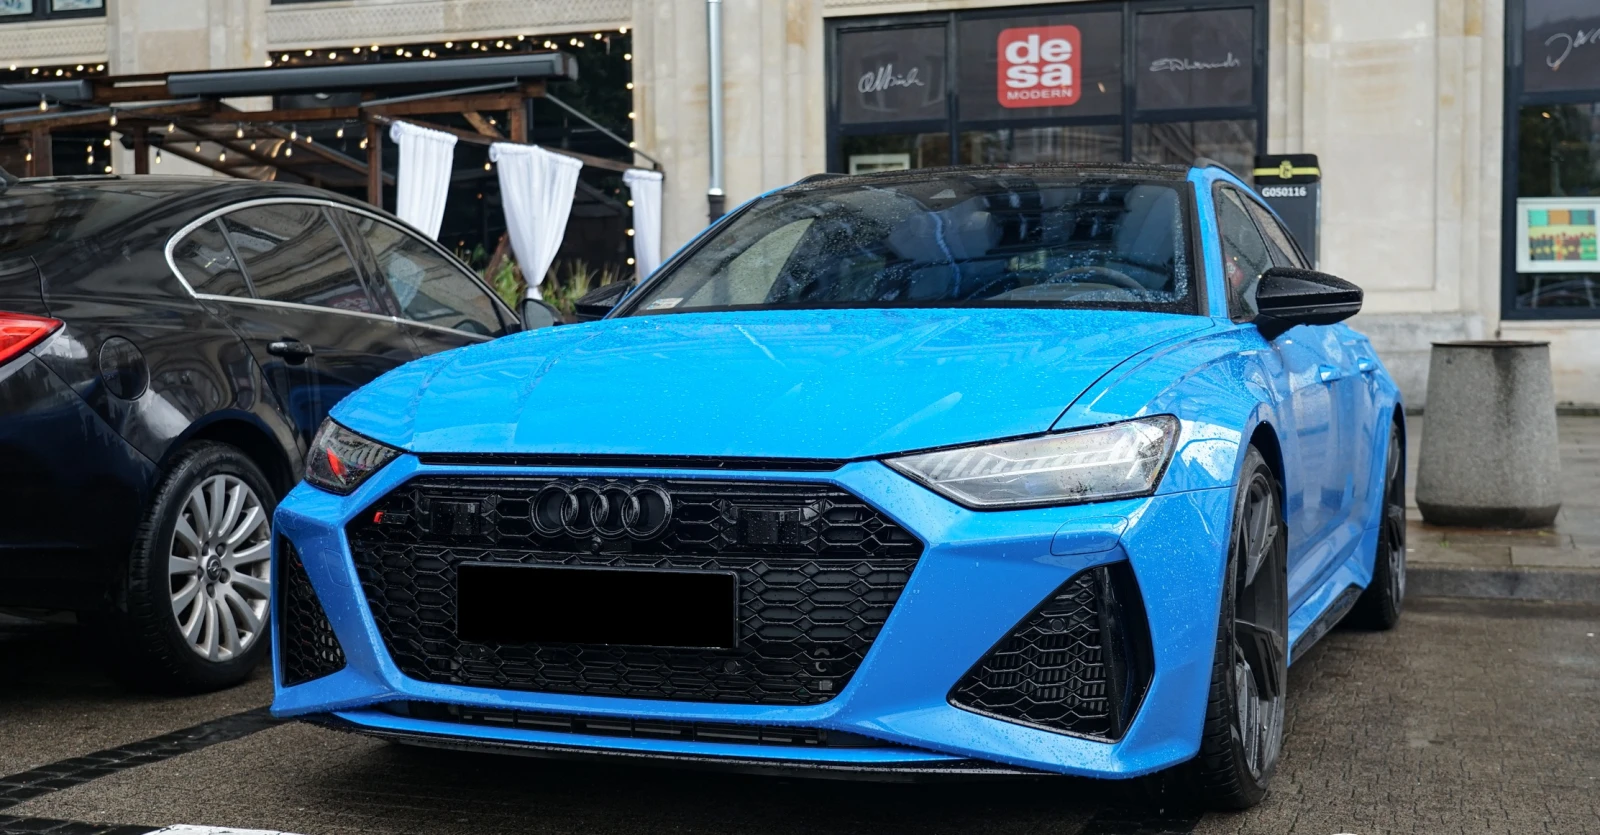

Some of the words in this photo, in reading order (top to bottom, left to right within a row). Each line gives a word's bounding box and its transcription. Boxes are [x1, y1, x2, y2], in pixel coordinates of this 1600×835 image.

[1005, 34, 1072, 65] de
[1005, 63, 1073, 88] sa
[1006, 88, 1073, 100] MODERN
